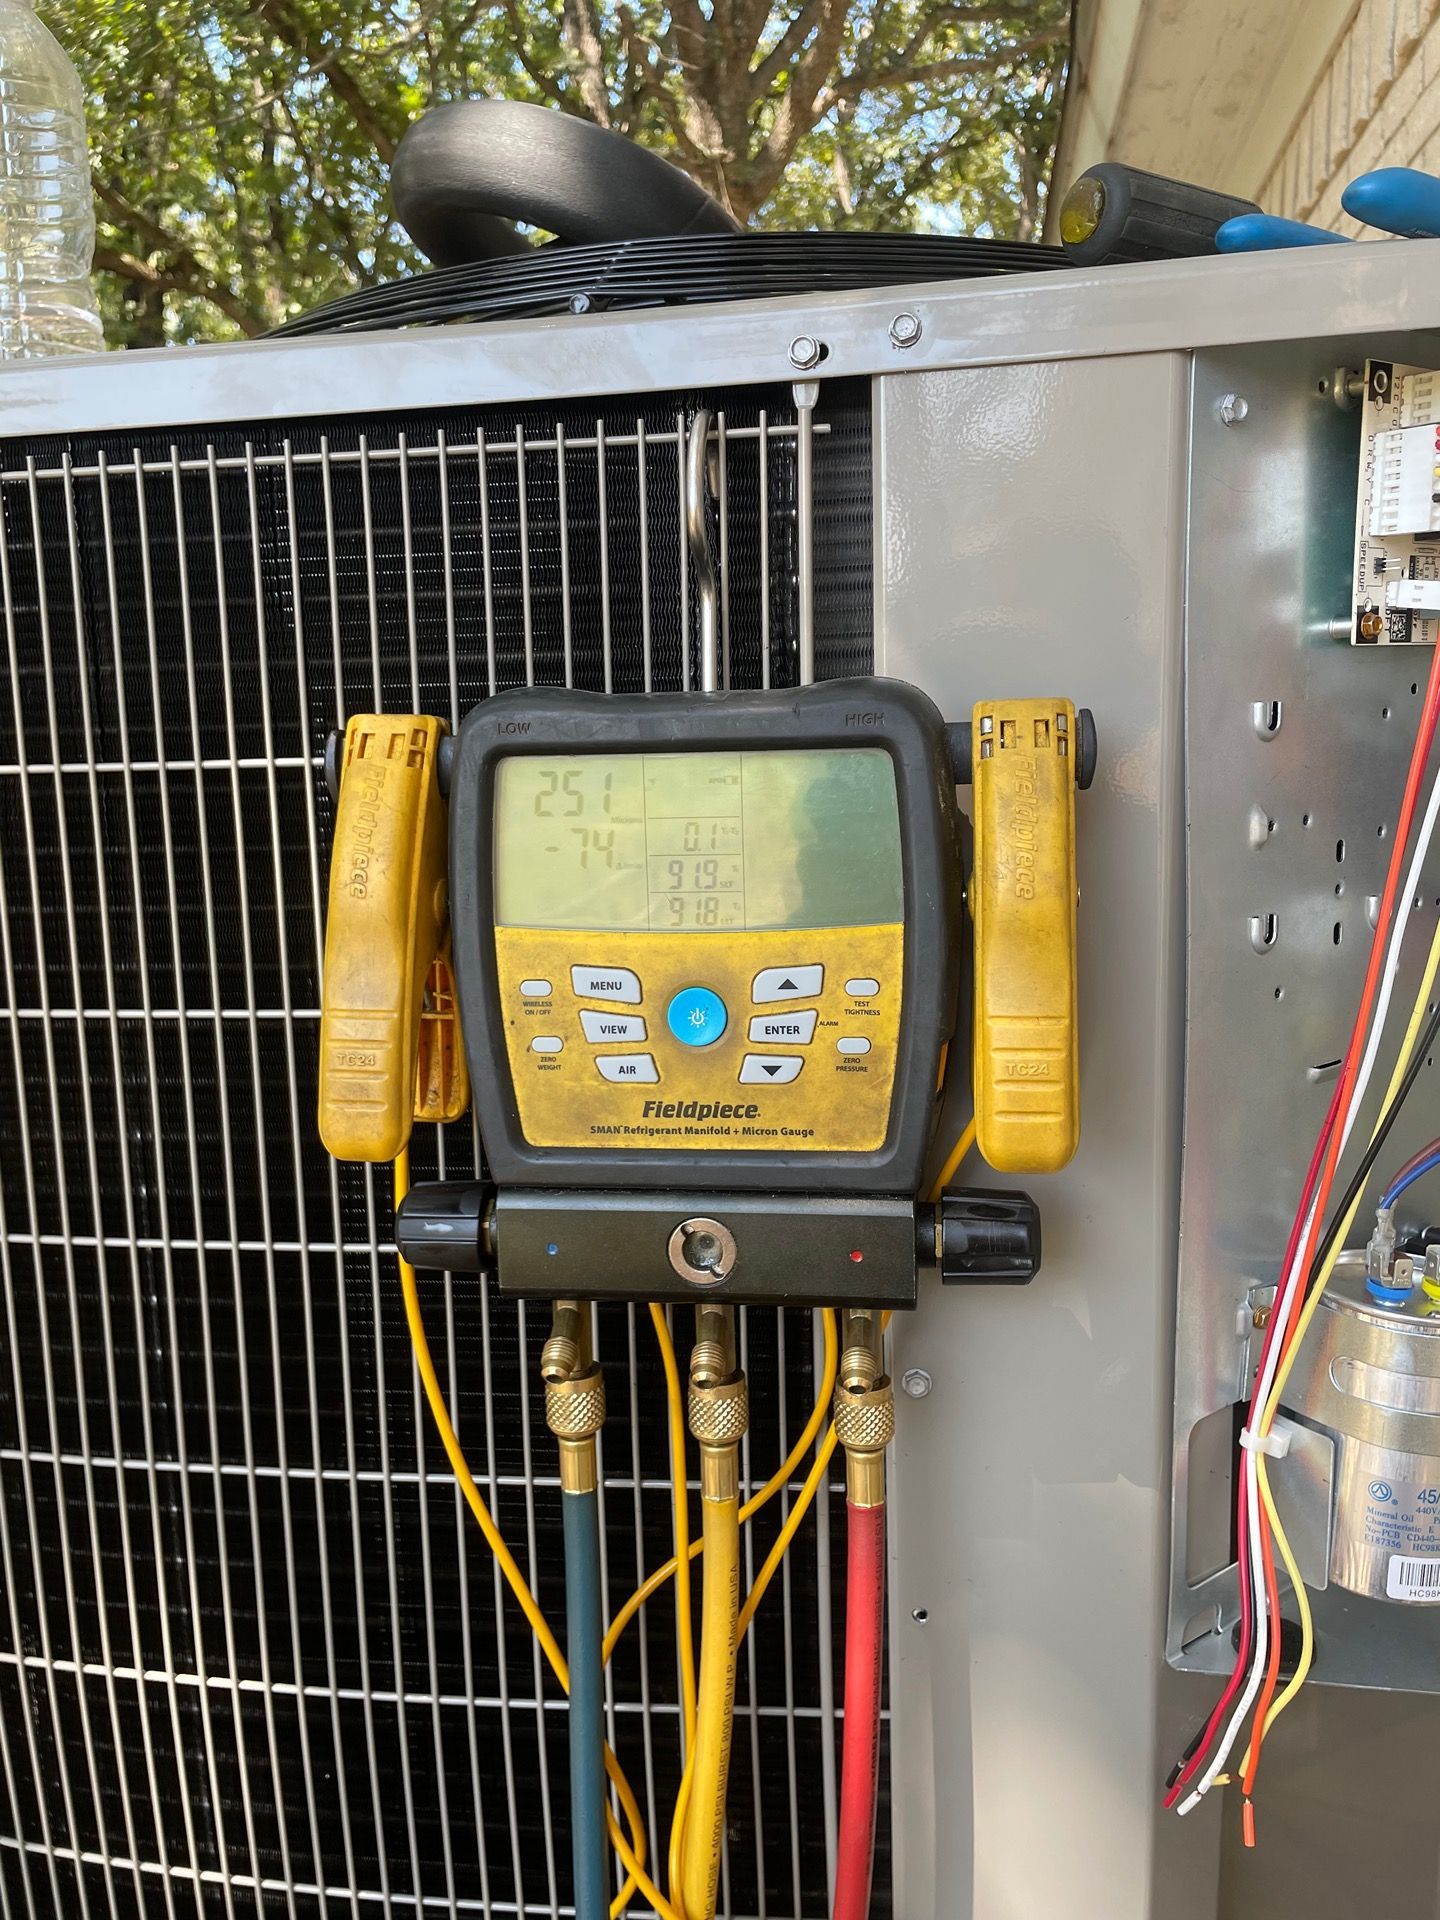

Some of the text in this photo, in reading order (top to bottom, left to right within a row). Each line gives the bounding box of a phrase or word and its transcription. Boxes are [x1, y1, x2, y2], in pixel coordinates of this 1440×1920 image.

[845, 712, 885, 727] HIGH
[498, 722, 531, 735] LOW
[534, 770, 613, 817] 251
[350, 763, 386, 900] Fieldpiece
[1011, 754, 1039, 900] Fieldpiece
[683, 821, 718, 852] 0.1
[590, 981, 622, 991] MENU
[600, 1025, 628, 1035] VIEW
[765, 1025, 801, 1035] ENTER
[336, 1053, 376, 1067] TC24
[618, 1065, 637, 1075] AIR
[1006, 1063, 1050, 1077] TC24
[642, 1101, 759, 1121] Fieldpiece
[623, 1125, 682, 1137] Refrigerant
[684, 1125, 731, 1136] Manifold
[742, 1126, 778, 1136] Micron
[780, 1127, 815, 1138] Gauge
[1367, 1506, 1398, 1520] Mineral
[1401, 1513, 1414, 1523] Oil
[1365, 1515, 1422, 1533] Characteristic
[1364, 1533, 1402, 1549] E187356
[729, 1563, 738, 1594] USA
[729, 1596, 737, 1609] in
[727, 1611, 737, 1647] Made
[723, 1692, 733, 1716] PSI
[717, 1747, 729, 1792] BURST
[715, 1795, 725, 1816] PSI
[706, 1861, 718, 1898] HOSE
